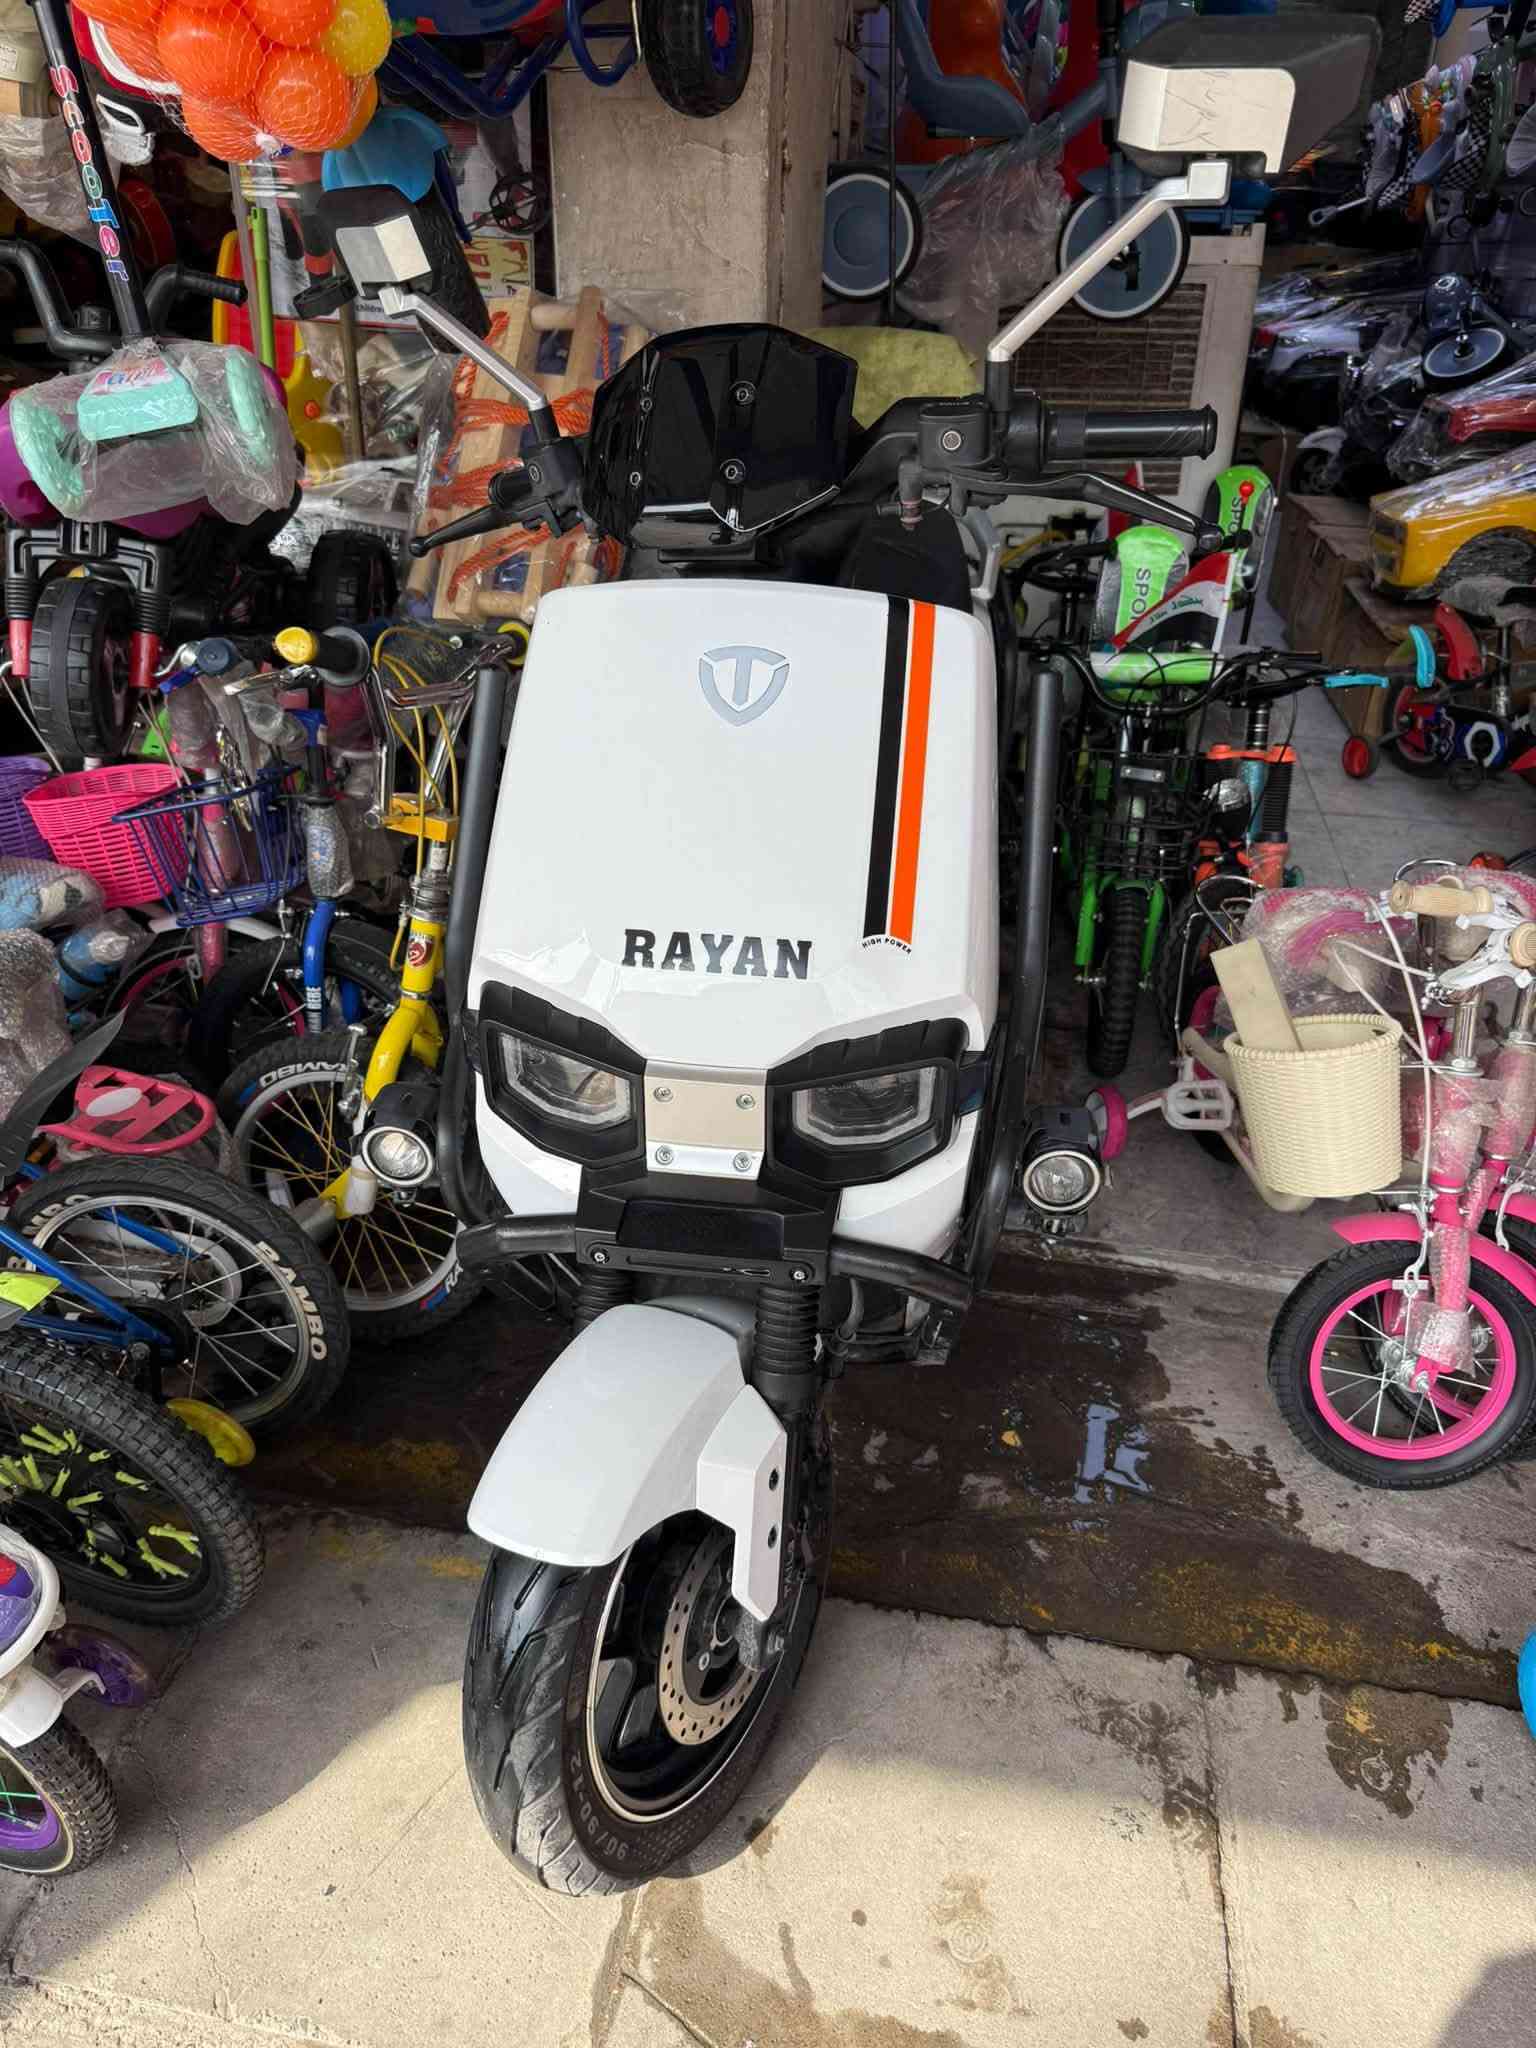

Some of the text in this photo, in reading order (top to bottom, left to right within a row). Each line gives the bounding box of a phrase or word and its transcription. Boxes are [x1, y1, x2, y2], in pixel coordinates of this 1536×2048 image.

[1130, 567, 1152, 620] SPO
[621, 928, 813, 980] RAYAN
[862, 937, 912, 955] HIGH POWER
[255, 1240, 328, 1361] RAMBO
